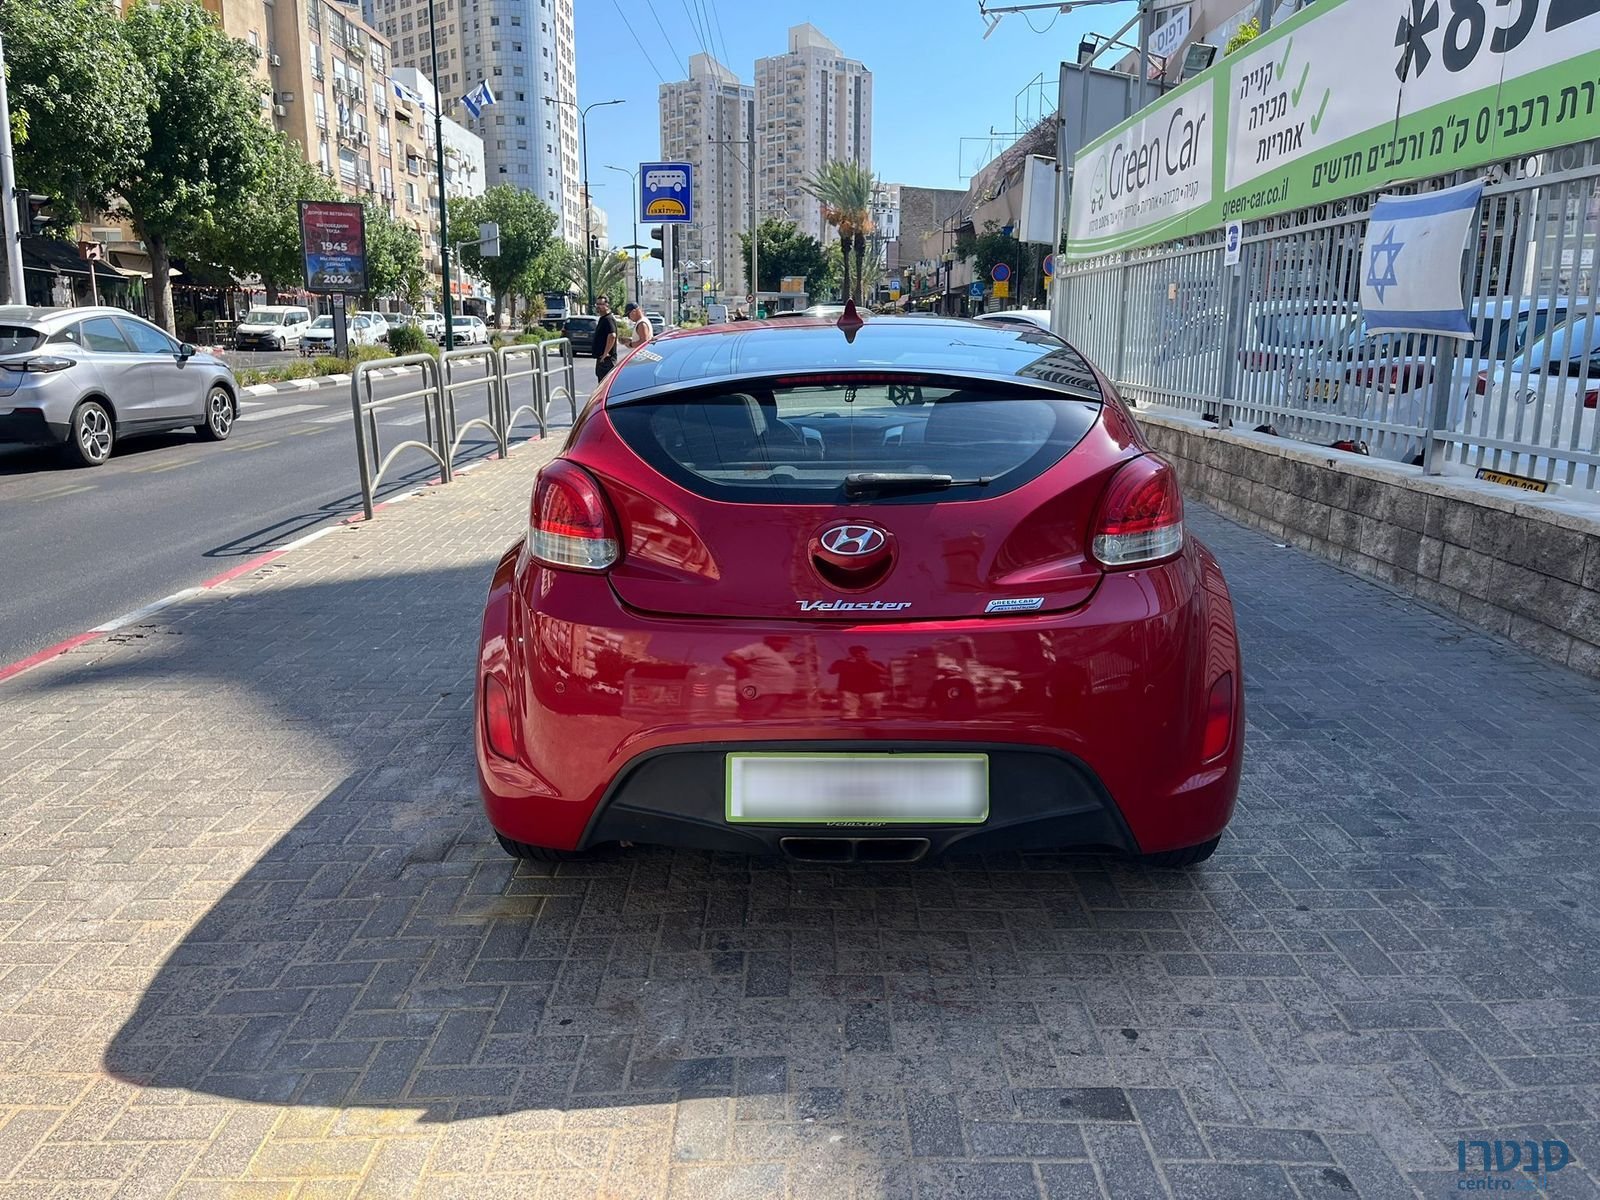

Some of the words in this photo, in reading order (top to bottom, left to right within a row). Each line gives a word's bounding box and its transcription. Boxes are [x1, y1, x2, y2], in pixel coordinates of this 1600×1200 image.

[1157, 16, 1184, 51] דפוס
[1240, 60, 1274, 99] קנייה
[1248, 91, 1288, 131] מכירה
[1498, 94, 1549, 138] רכבי
[1556, 78, 1600, 123] רת
[1255, 122, 1305, 164] אחריות
[1475, 106, 1490, 145] 0
[1109, 137, 1160, 201] Green
[1165, 107, 1206, 176] Car
[1311, 150, 1363, 188] חדשים
[1367, 130, 1425, 173] ורכבים
[1222, 177, 1289, 220] green-car.co.il
[320, 242, 348, 251] 1945
[323, 275, 352, 284] 2024
[795, 599, 912, 611] Veloster
